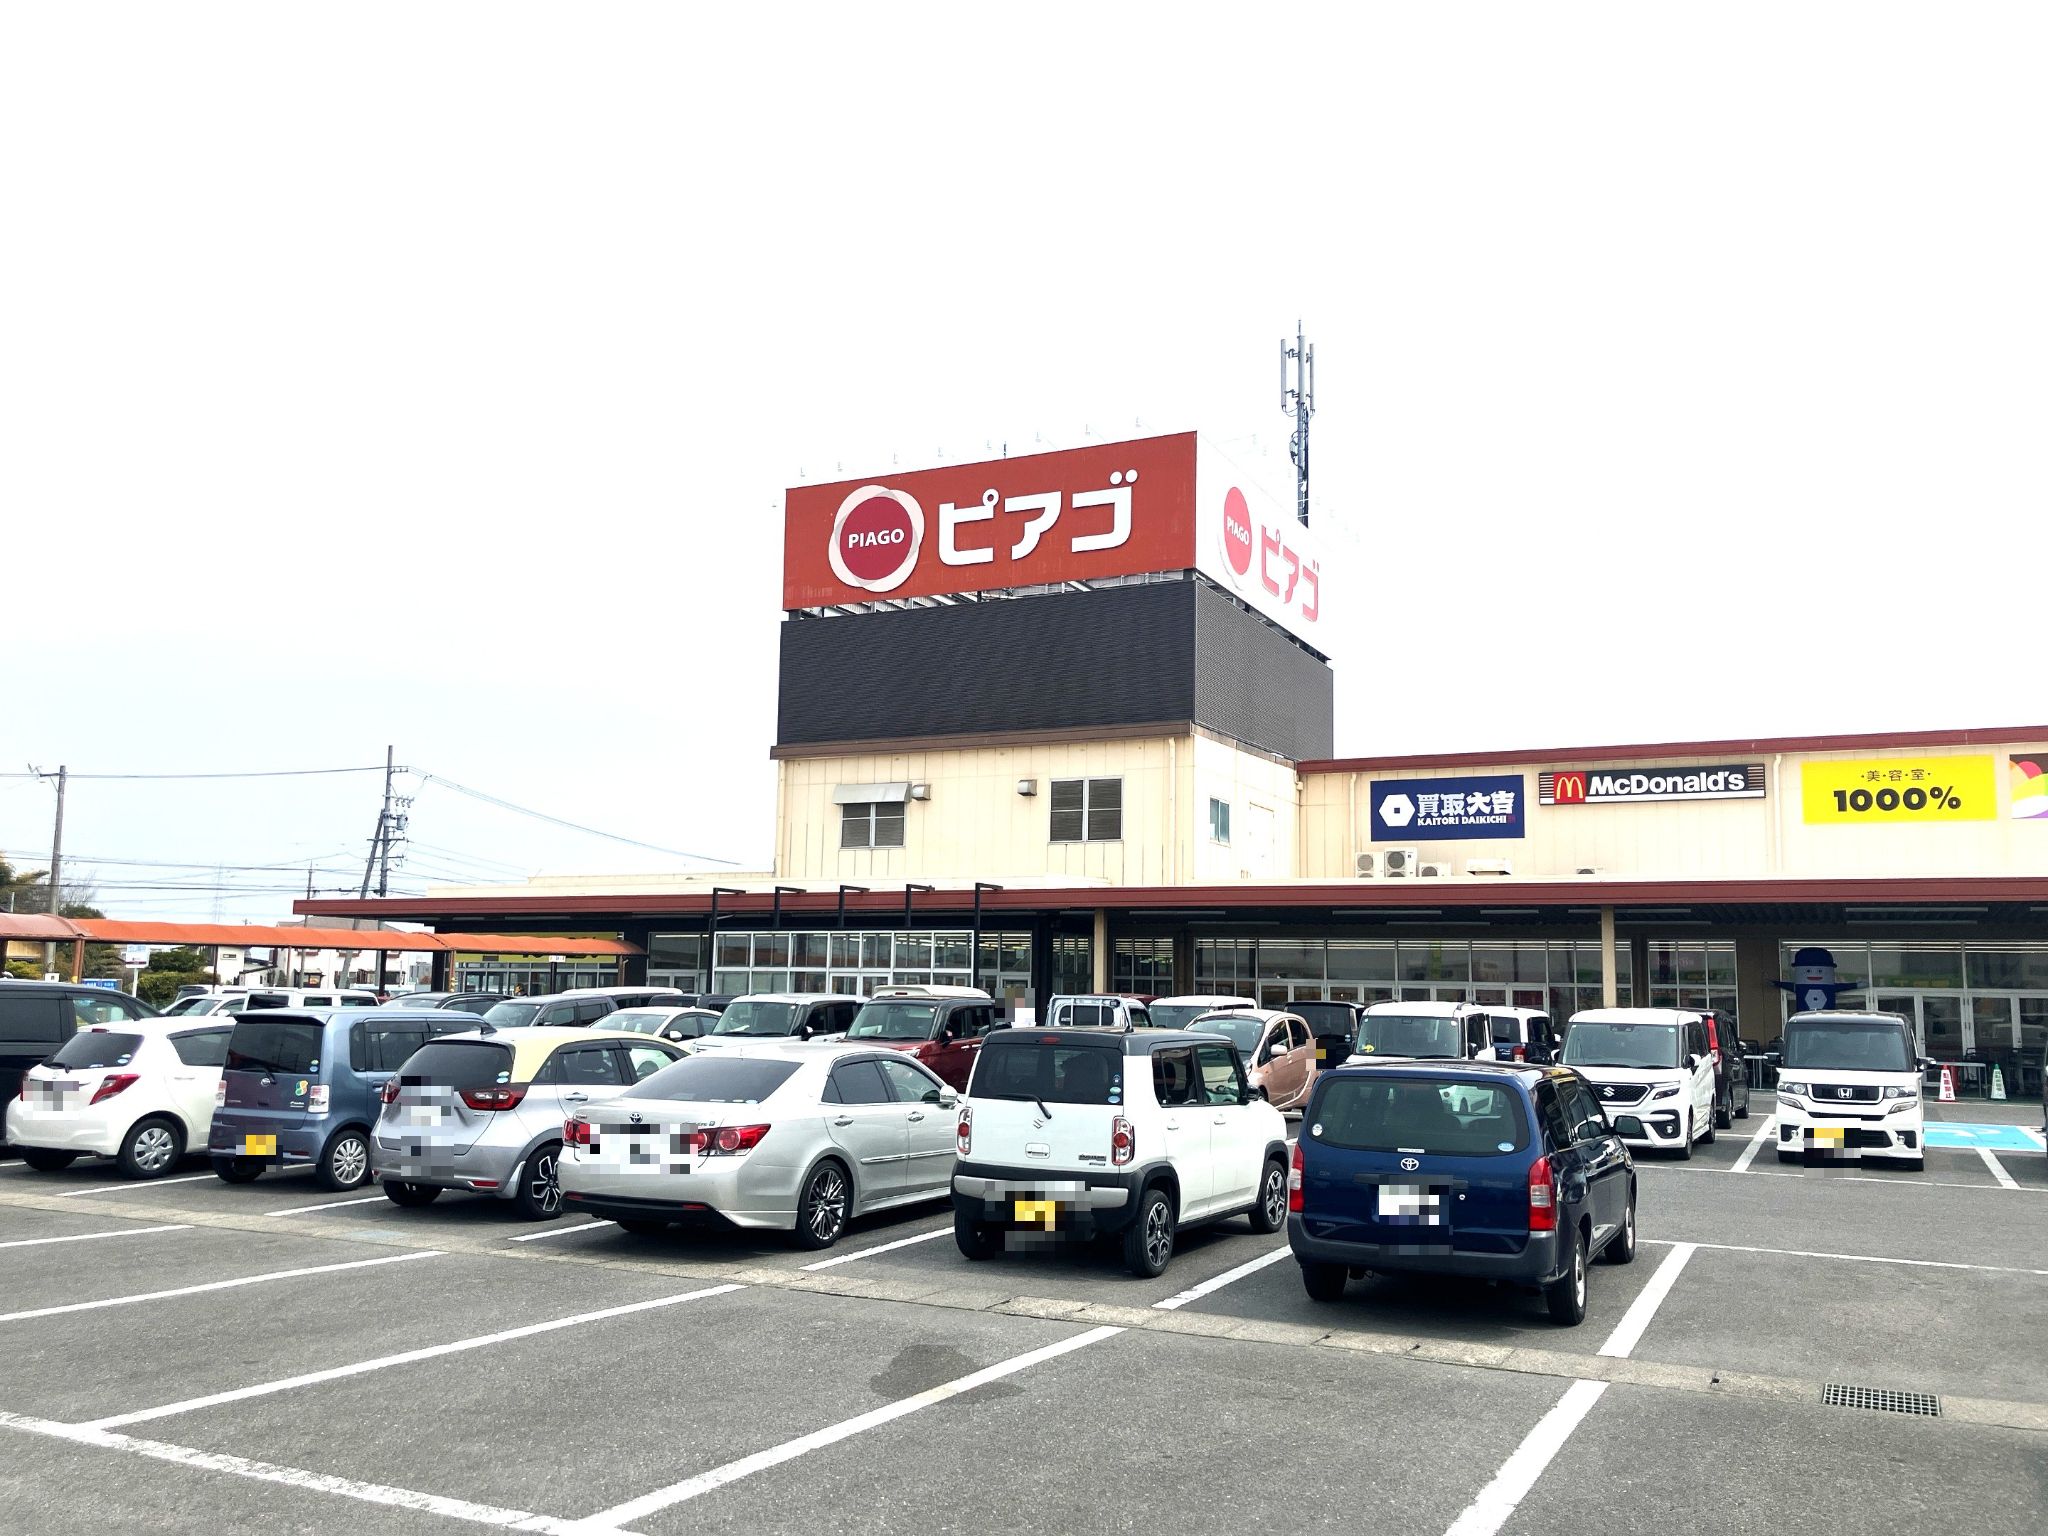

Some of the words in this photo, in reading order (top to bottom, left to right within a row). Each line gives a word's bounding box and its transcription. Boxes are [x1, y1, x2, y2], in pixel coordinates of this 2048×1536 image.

[939, 469, 1138, 565] ピアゴ
[848, 528, 905, 549] PIAGO
[1226, 515, 1250, 546] PIAGO
[1261, 524, 1320, 623] ピアゴ
[1589, 771, 1746, 795] McDonald's
[1416, 790, 1515, 817] 買取大吉
[1833, 786, 1962, 812] 1000%
[1417, 816, 1459, 826] KAITORI
[1461, 815, 1507, 825] DAIKICHI
